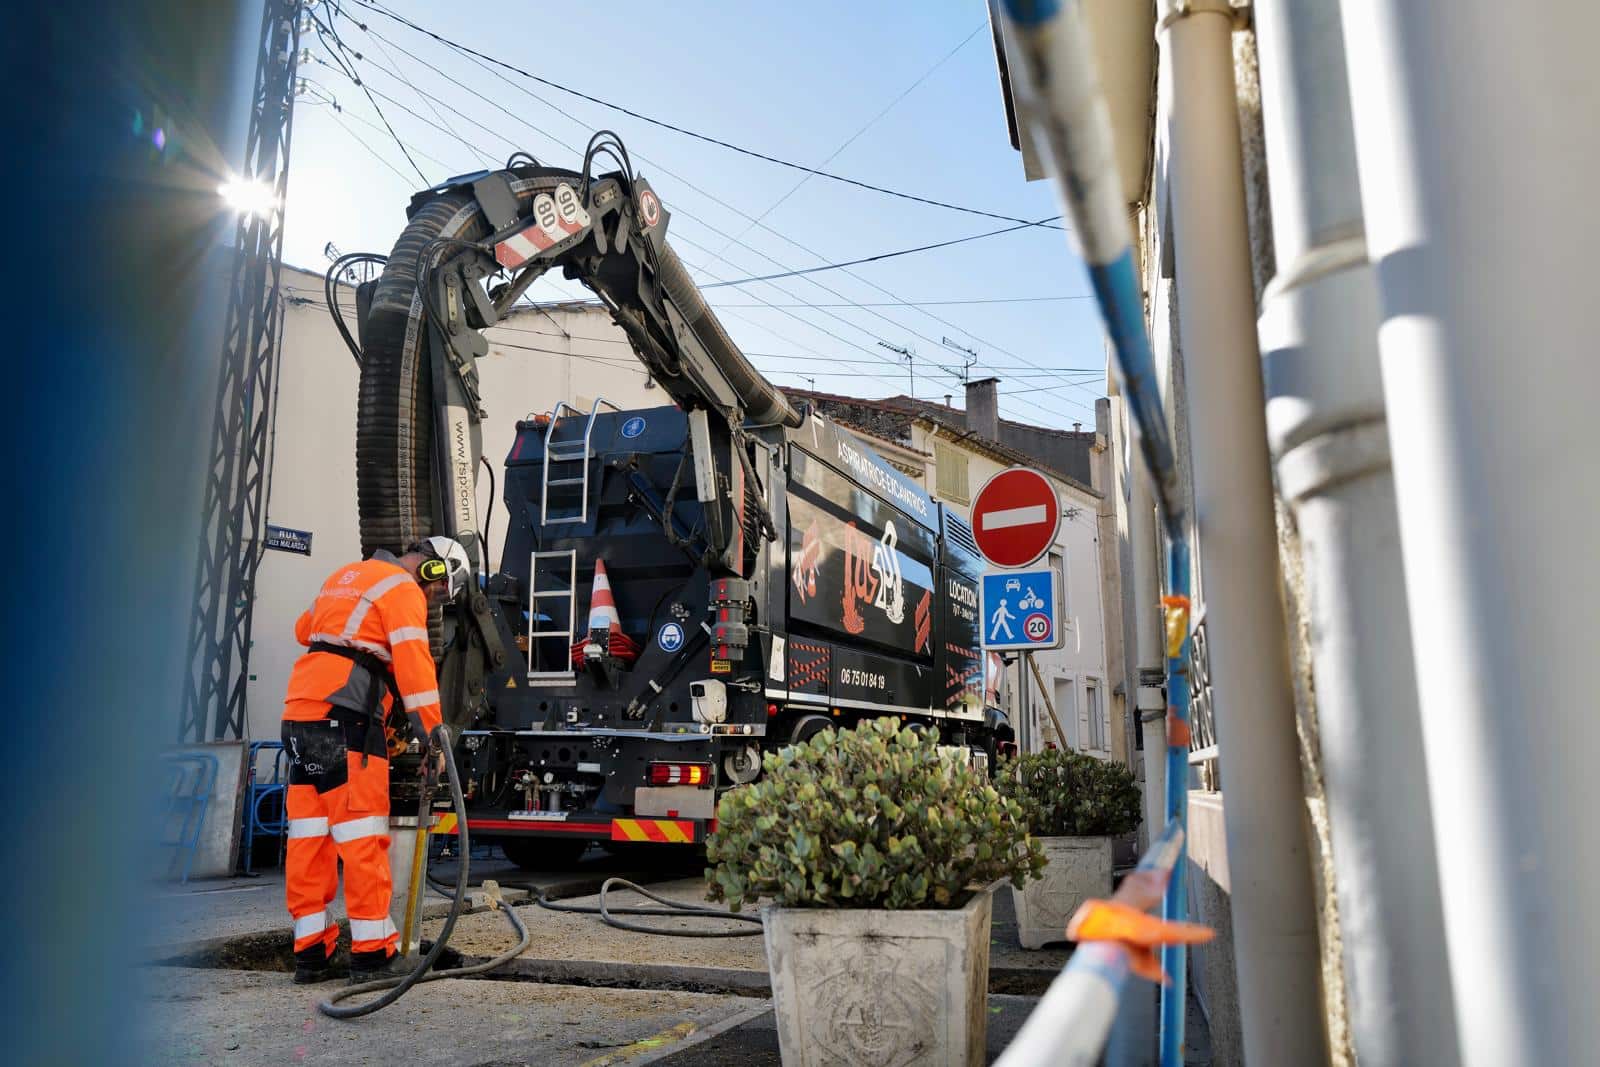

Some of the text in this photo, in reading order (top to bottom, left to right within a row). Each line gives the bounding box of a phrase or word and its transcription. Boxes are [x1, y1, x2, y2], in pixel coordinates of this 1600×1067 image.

[537, 201, 556, 228] 80
[559, 190, 576, 217] 90
[279, 530, 297, 539] RUE
[949, 578, 977, 608] LOCATION
[1029, 621, 1046, 634] 20
[840, 667, 885, 690] 06 75 01 84 19
